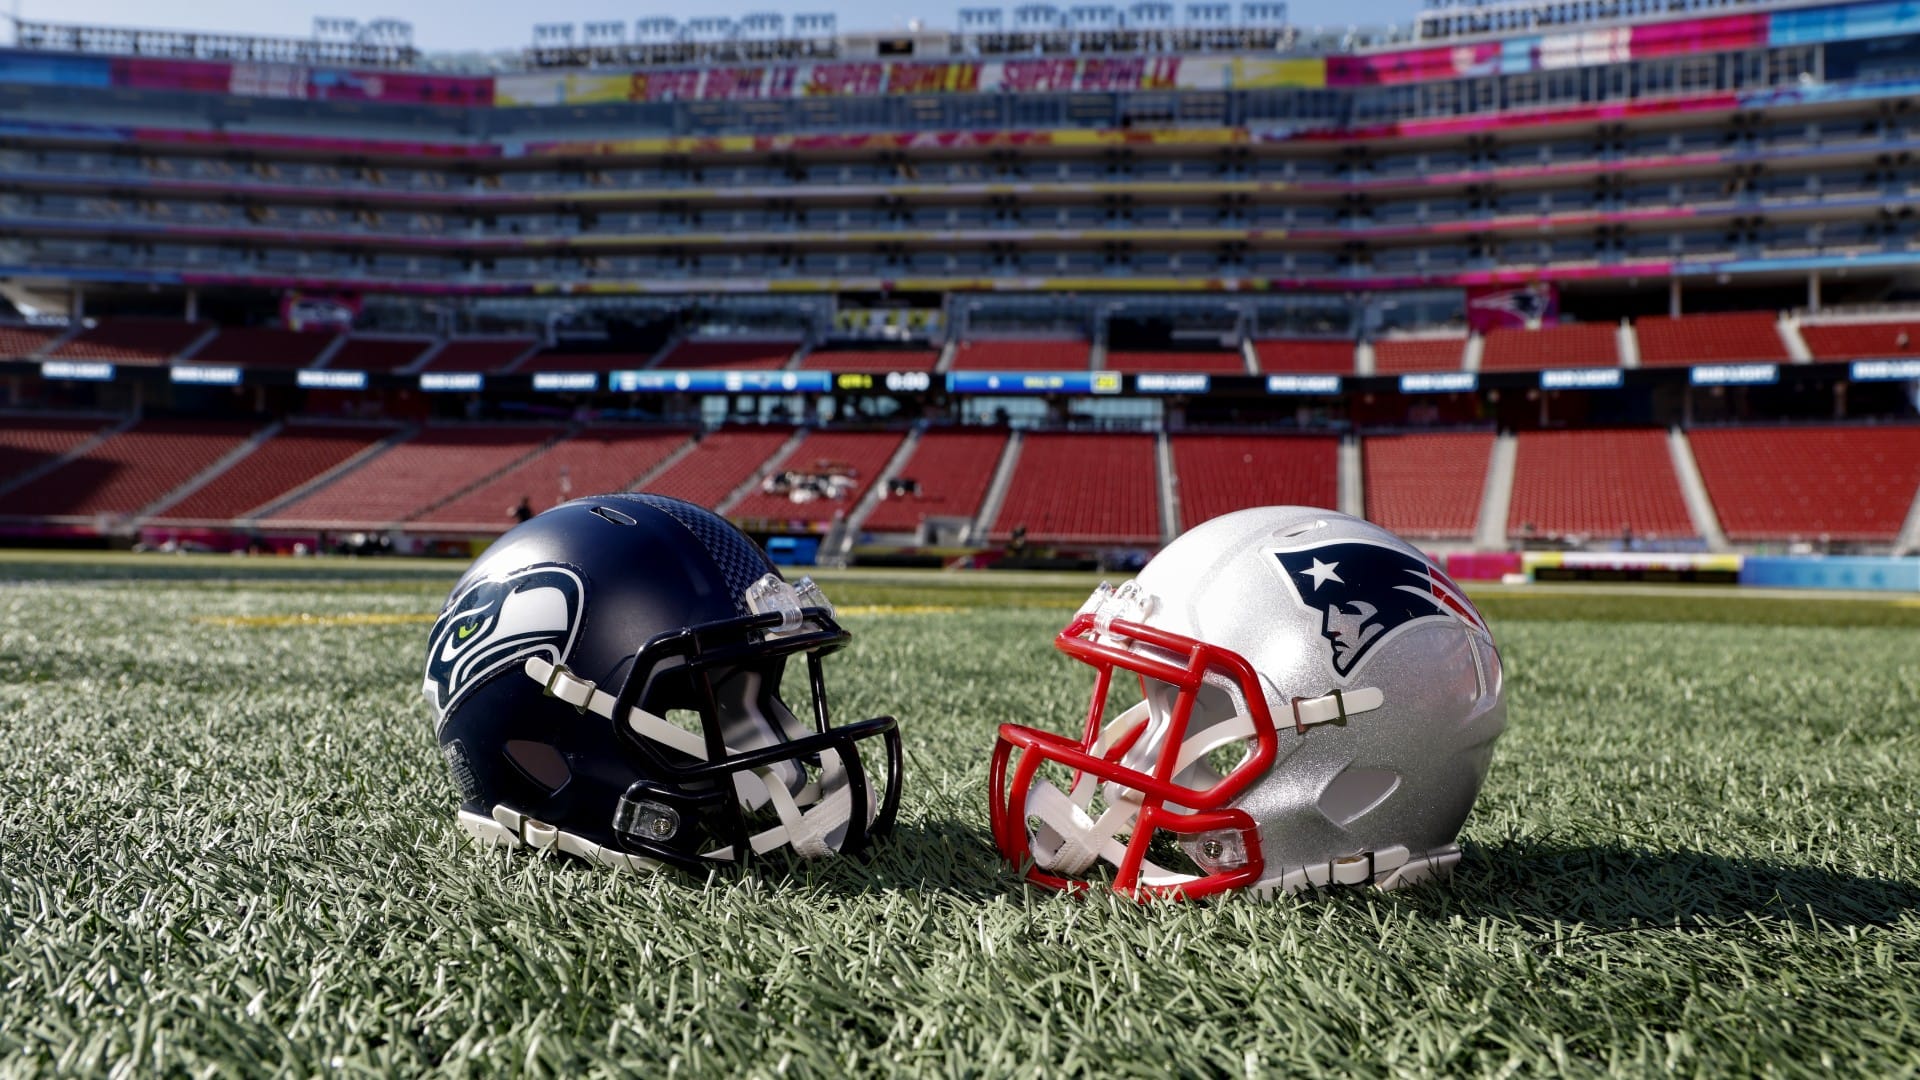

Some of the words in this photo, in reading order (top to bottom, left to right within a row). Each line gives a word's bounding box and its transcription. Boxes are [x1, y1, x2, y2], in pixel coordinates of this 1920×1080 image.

[810, 63, 883, 95] SUPER
[886, 62, 950, 93] BOWL
[1001, 58, 1077, 91] SUPER
[1080, 57, 1147, 90] BOWL
[628, 69, 702, 100] SUPER
[703, 67, 766, 99] BOWL
[421, 374, 444, 389] BUD
[446, 374, 480, 389] LIGHT
[534, 374, 558, 389] BUD
[560, 374, 595, 389] LIGHT
[886, 371, 930, 391] 0:00
[1138, 375, 1164, 390] BUD
[1166, 375, 1206, 391] LIGHT
[1402, 376, 1431, 391] BUD
[1433, 374, 1474, 390] LIGHT
[1542, 371, 1573, 387] BUD
[1575, 369, 1619, 386] LIGHT
[1692, 368, 1725, 384] BUD
[1727, 365, 1774, 382] LIGHT
[1269, 376, 1296, 391] BUD
[1298, 376, 1338, 392] LIGHT
